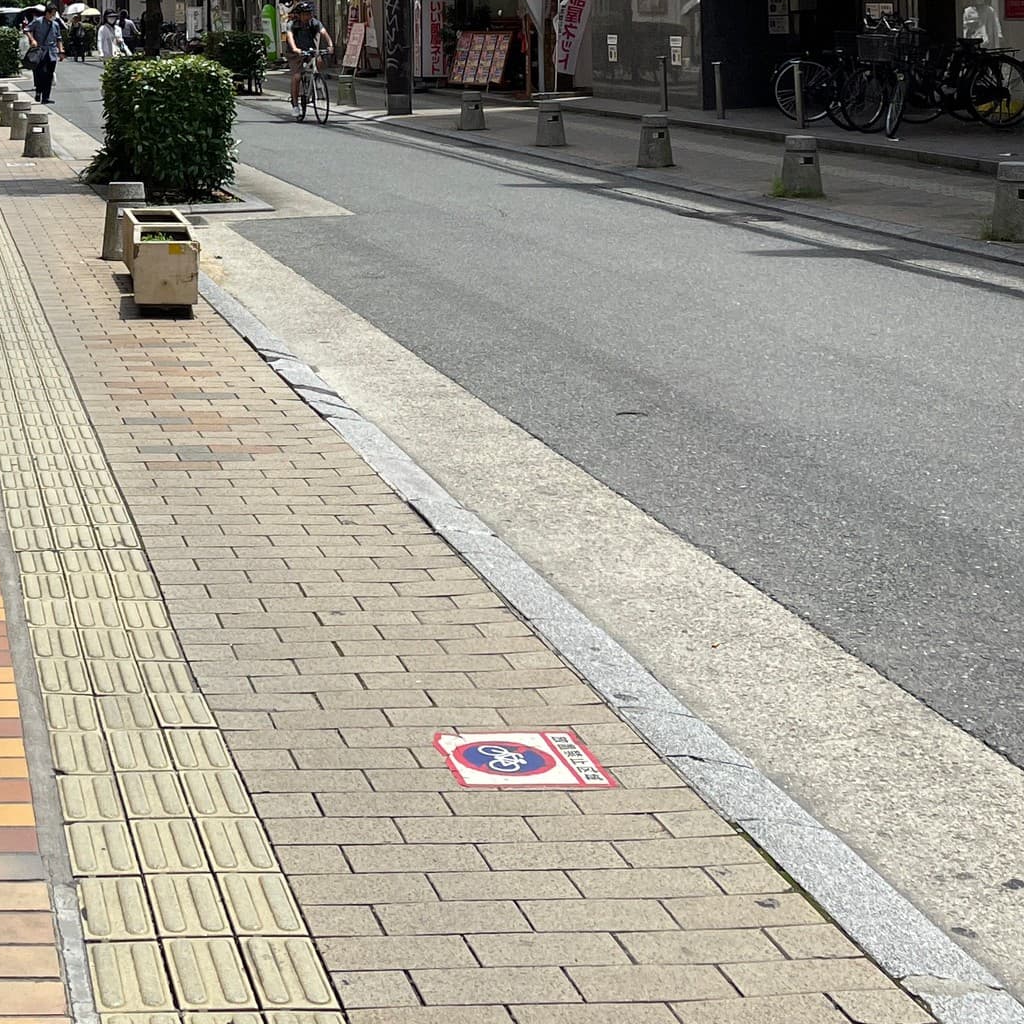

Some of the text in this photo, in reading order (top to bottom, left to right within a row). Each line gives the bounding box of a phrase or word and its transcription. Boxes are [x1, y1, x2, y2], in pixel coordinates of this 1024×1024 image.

[430, 1, 441, 75] いい部屋ネット
